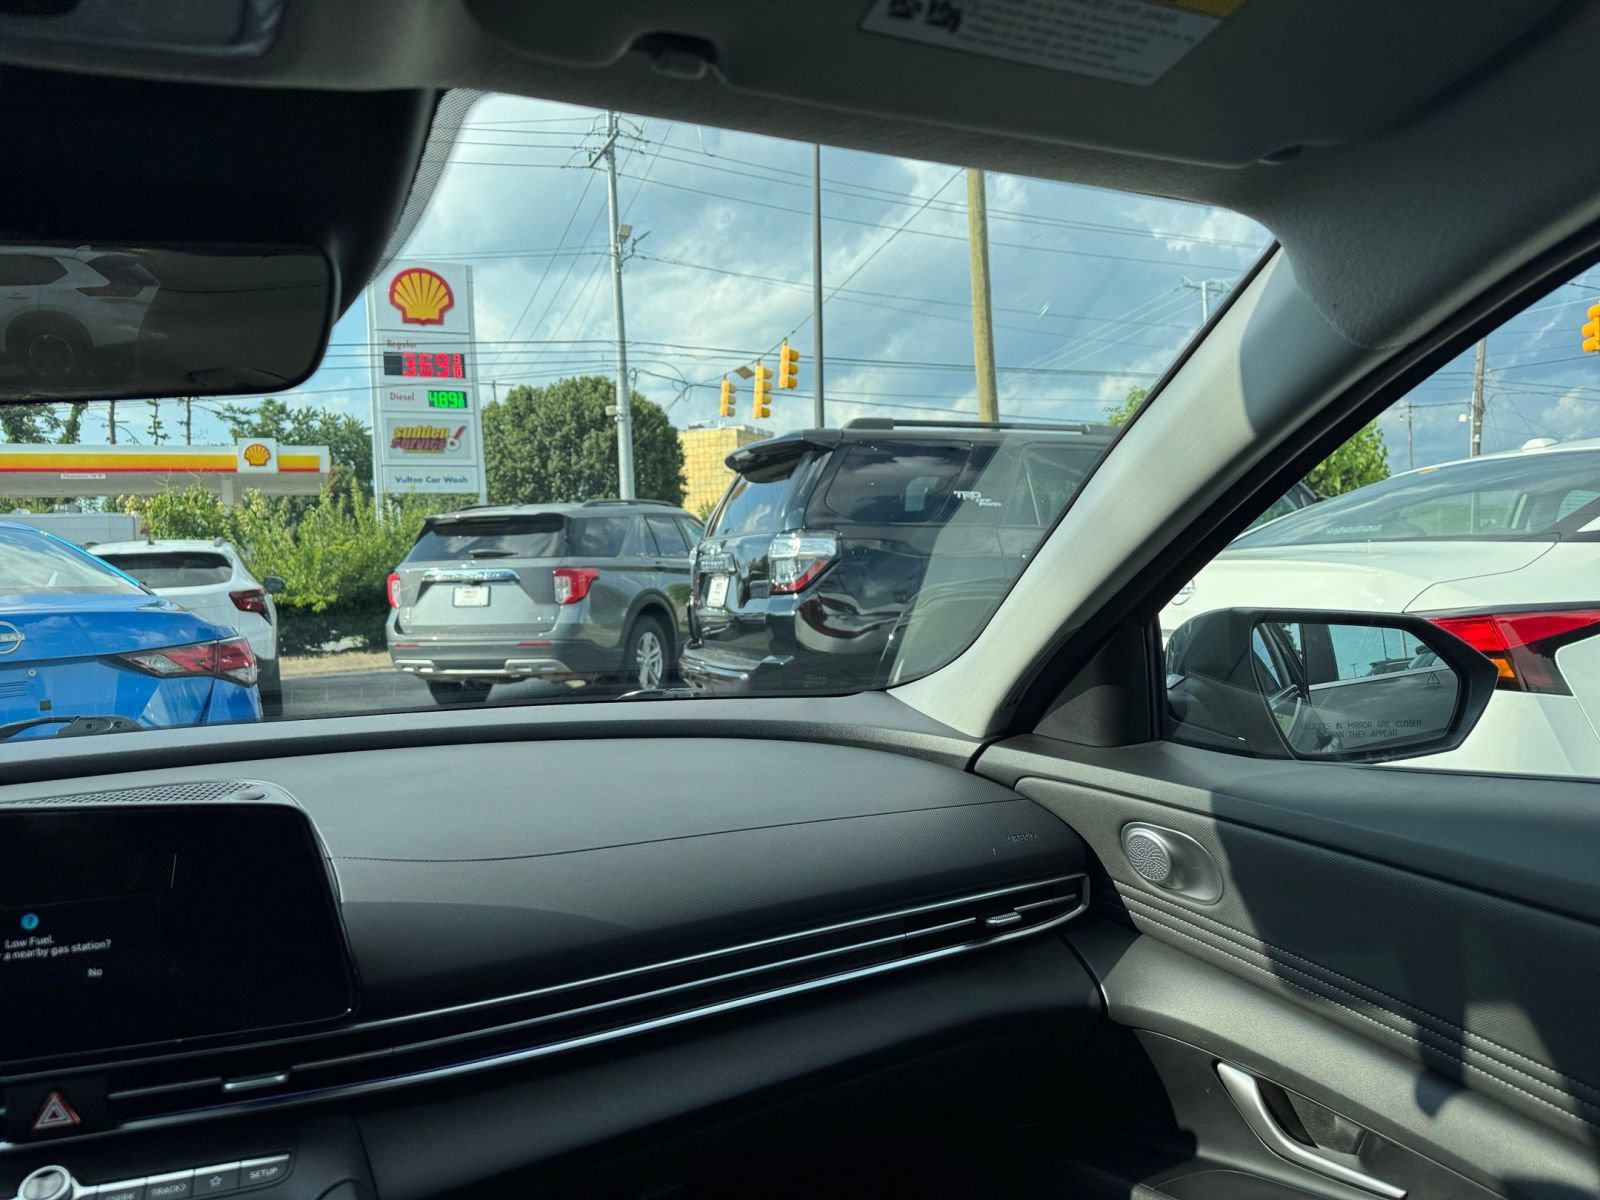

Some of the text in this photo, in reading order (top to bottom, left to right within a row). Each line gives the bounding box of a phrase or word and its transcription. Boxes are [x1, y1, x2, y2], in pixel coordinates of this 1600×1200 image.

[390, 392, 415, 401] Diesel
[425, 475, 440, 483] Car
[444, 475, 468, 483] Wash
[1348, 720, 1372, 729] MIRROR
[1377, 720, 1390, 728] ARE
[1396, 719, 1422, 727] CLOSER
[1371, 728, 1398, 737] APPEAR
[4, 939, 27, 949] Low
[3, 951, 11, 960] a
[12, 947, 49, 959] nearby
[50, 945, 69, 957] gas
[71, 939, 112, 952] station?
[87, 968, 103, 977] No
[250, 1166, 278, 1178] SETUP
